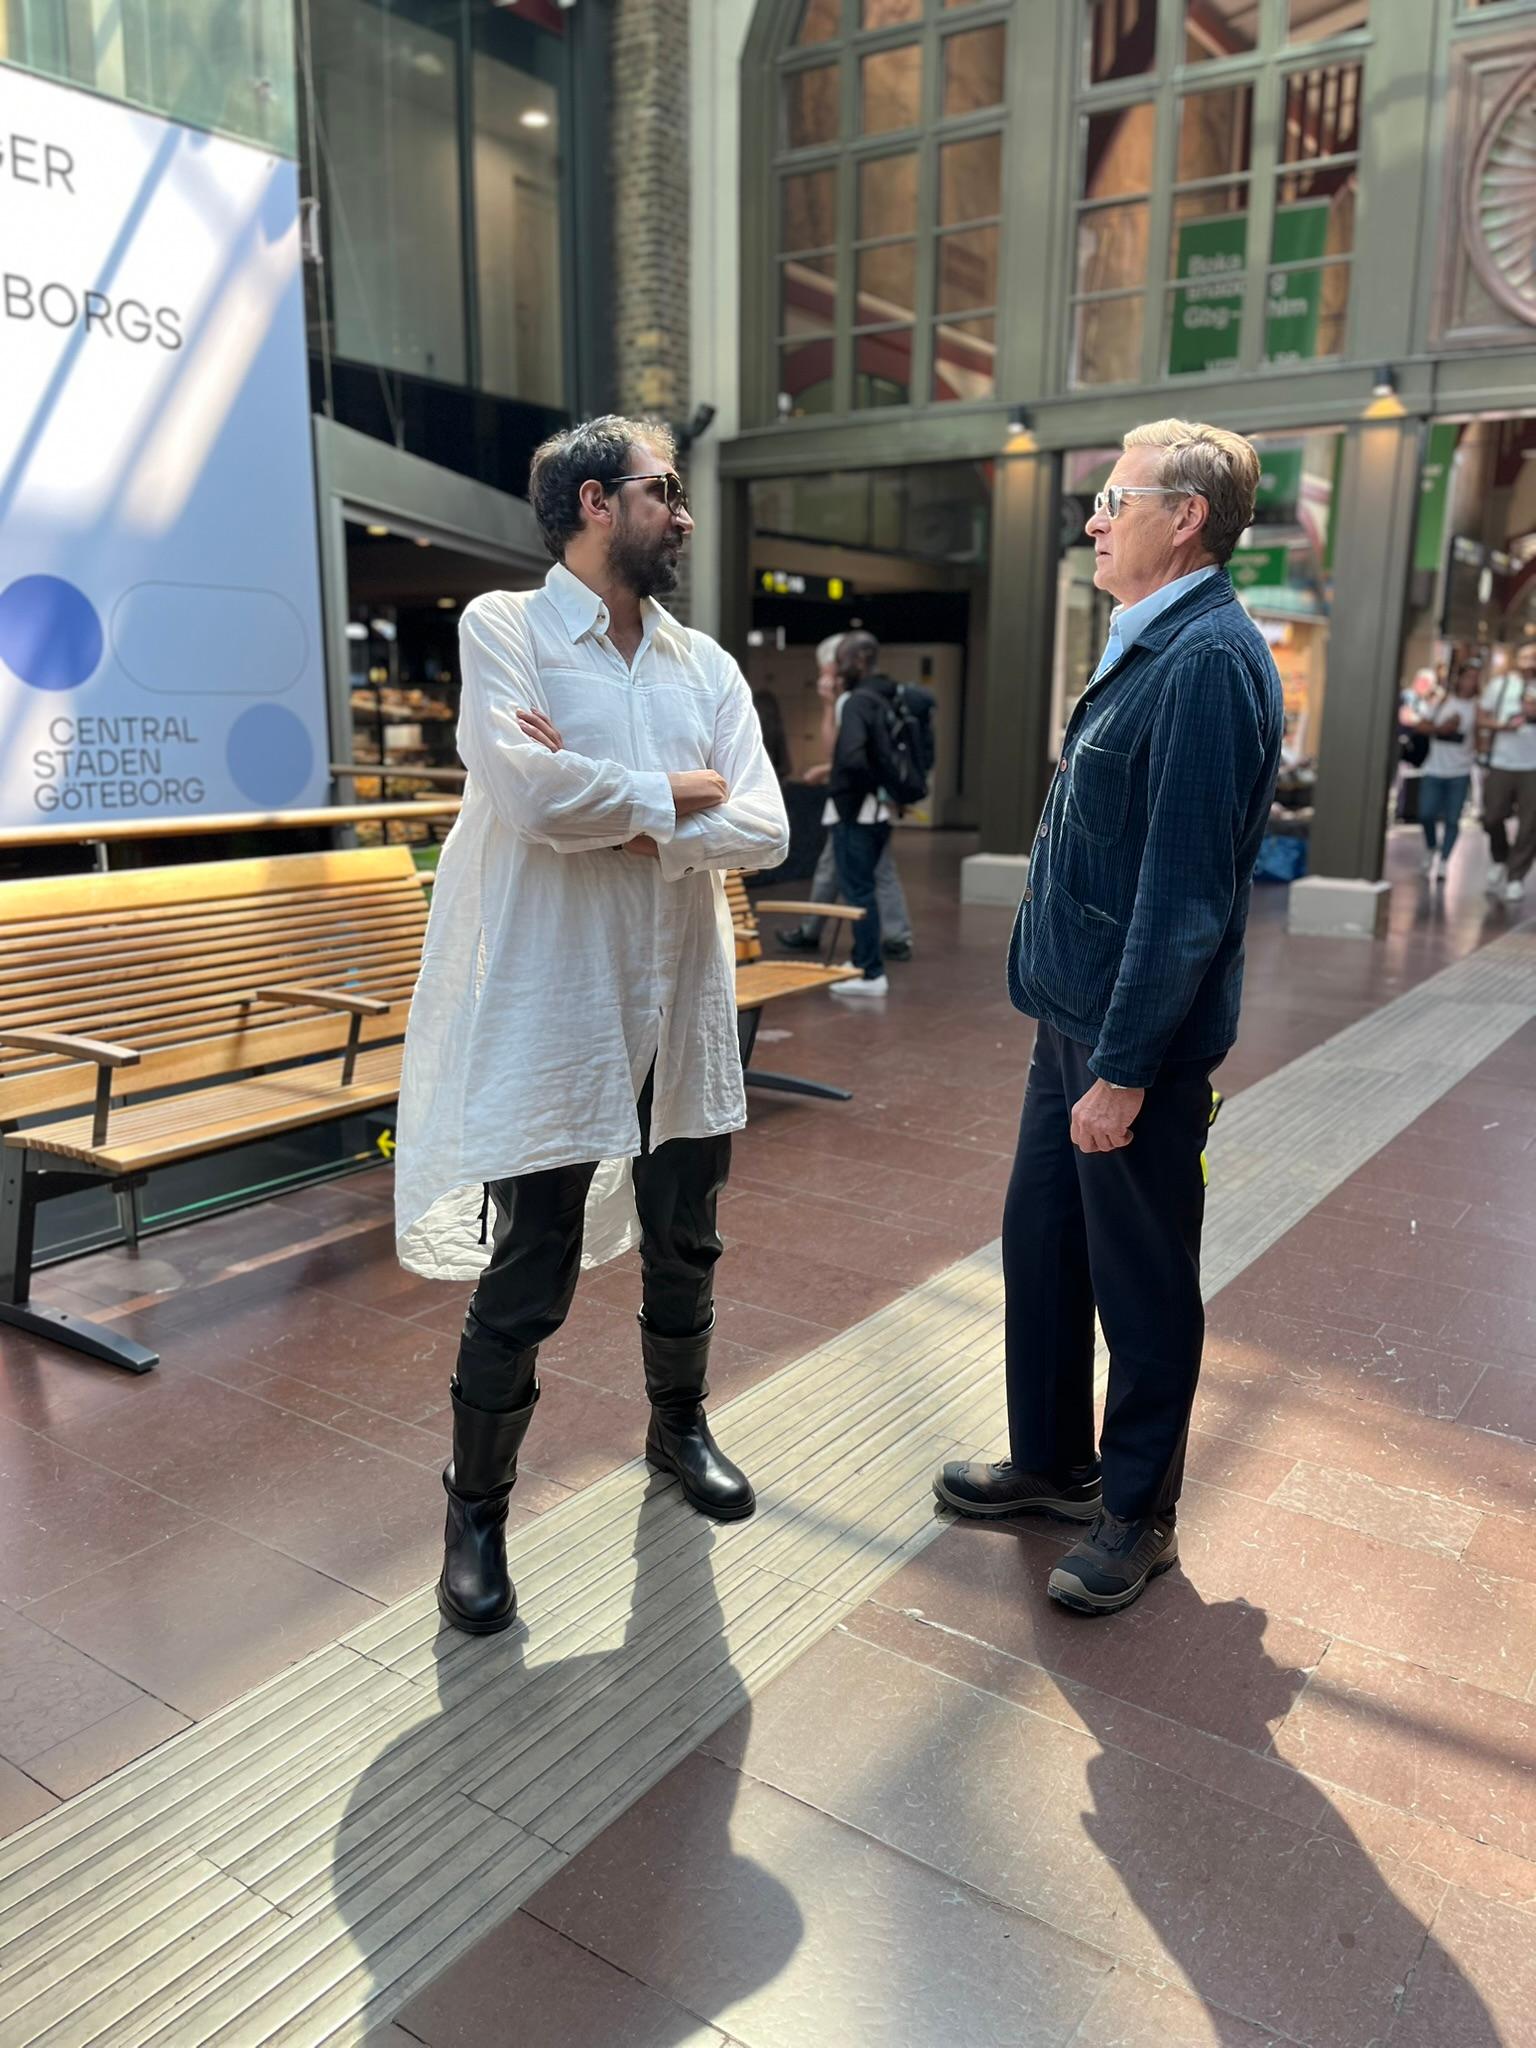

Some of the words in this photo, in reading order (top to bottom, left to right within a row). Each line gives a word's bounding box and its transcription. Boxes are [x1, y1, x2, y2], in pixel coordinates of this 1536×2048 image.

[0, 133, 76, 195] ER
[3, 273, 183, 351] BORGS
[50, 717, 198, 746] CENTRAL
[33, 749, 162, 779] STADEN
[33, 777, 205, 812] GÖTEBORG
